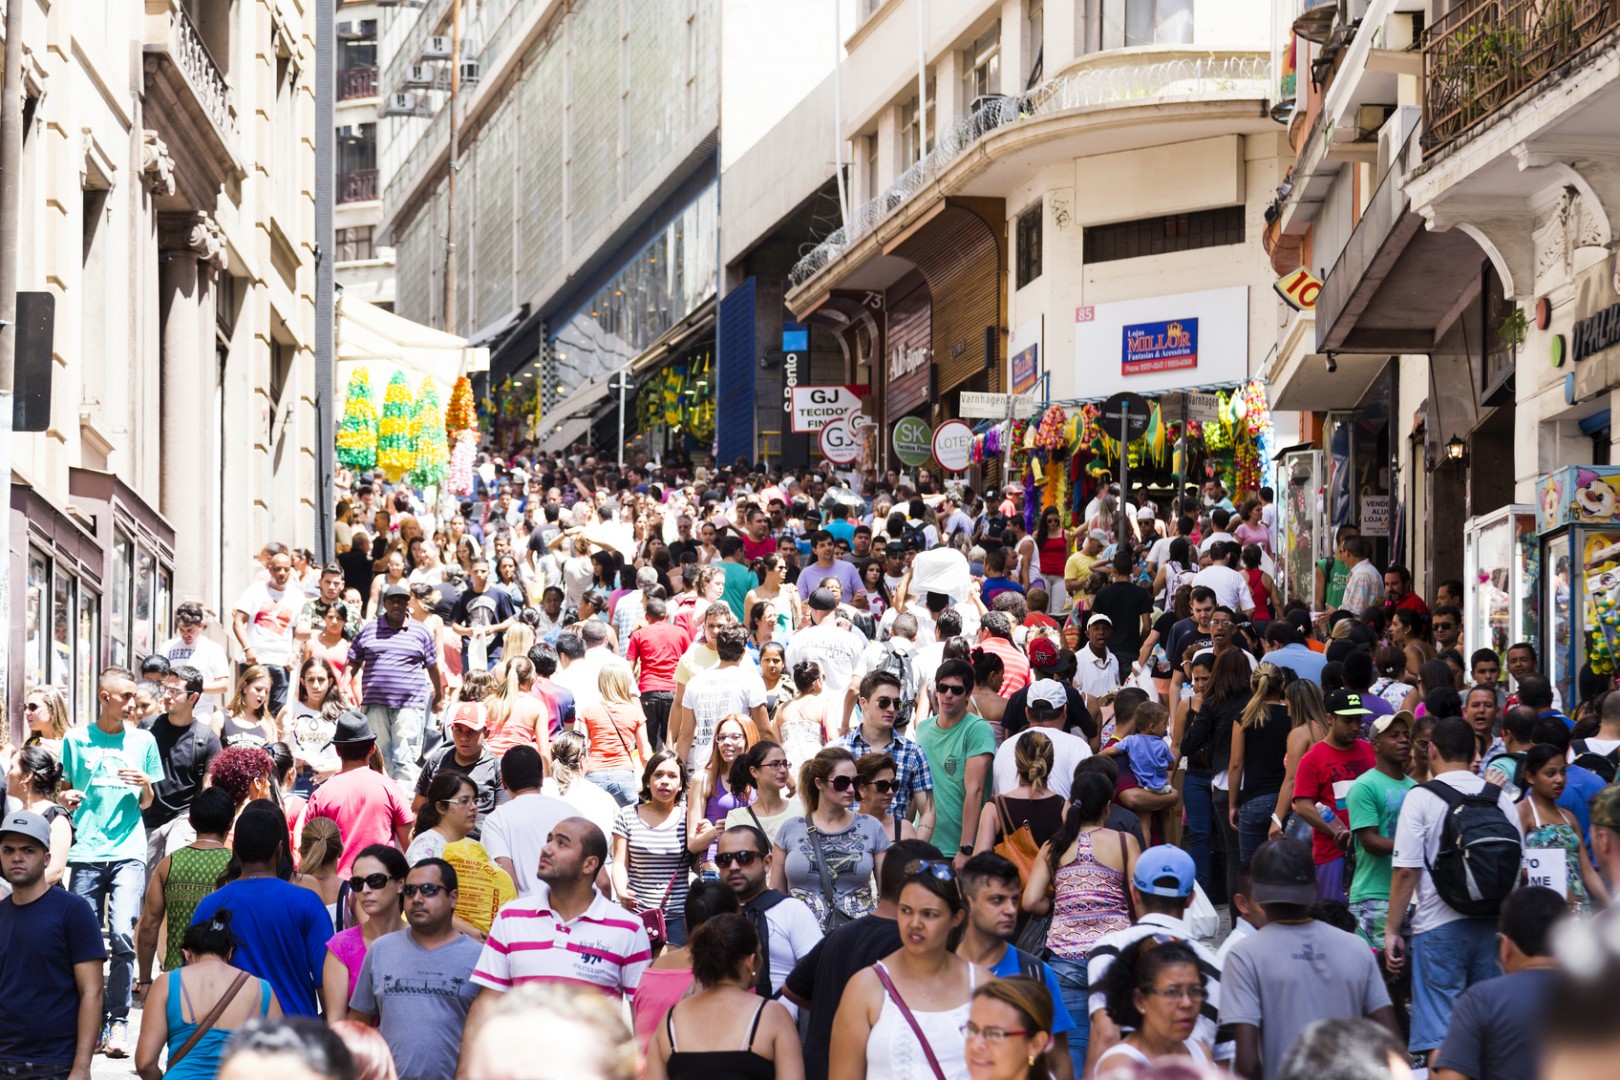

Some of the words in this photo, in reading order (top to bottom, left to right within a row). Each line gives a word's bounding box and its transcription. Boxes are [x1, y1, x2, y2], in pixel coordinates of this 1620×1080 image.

[862, 291, 883, 309] 73
[1078, 309, 1092, 321] 85
[1127, 329, 1145, 338] Lojas
[1127, 332, 1191, 353] MILLOR
[1128, 352, 1154, 361] Fantasias
[1155, 350, 1160, 358] &
[810, 390, 840, 404] GJ
[961, 393, 1005, 408] Varnhagen
[901, 423, 925, 443] SK
